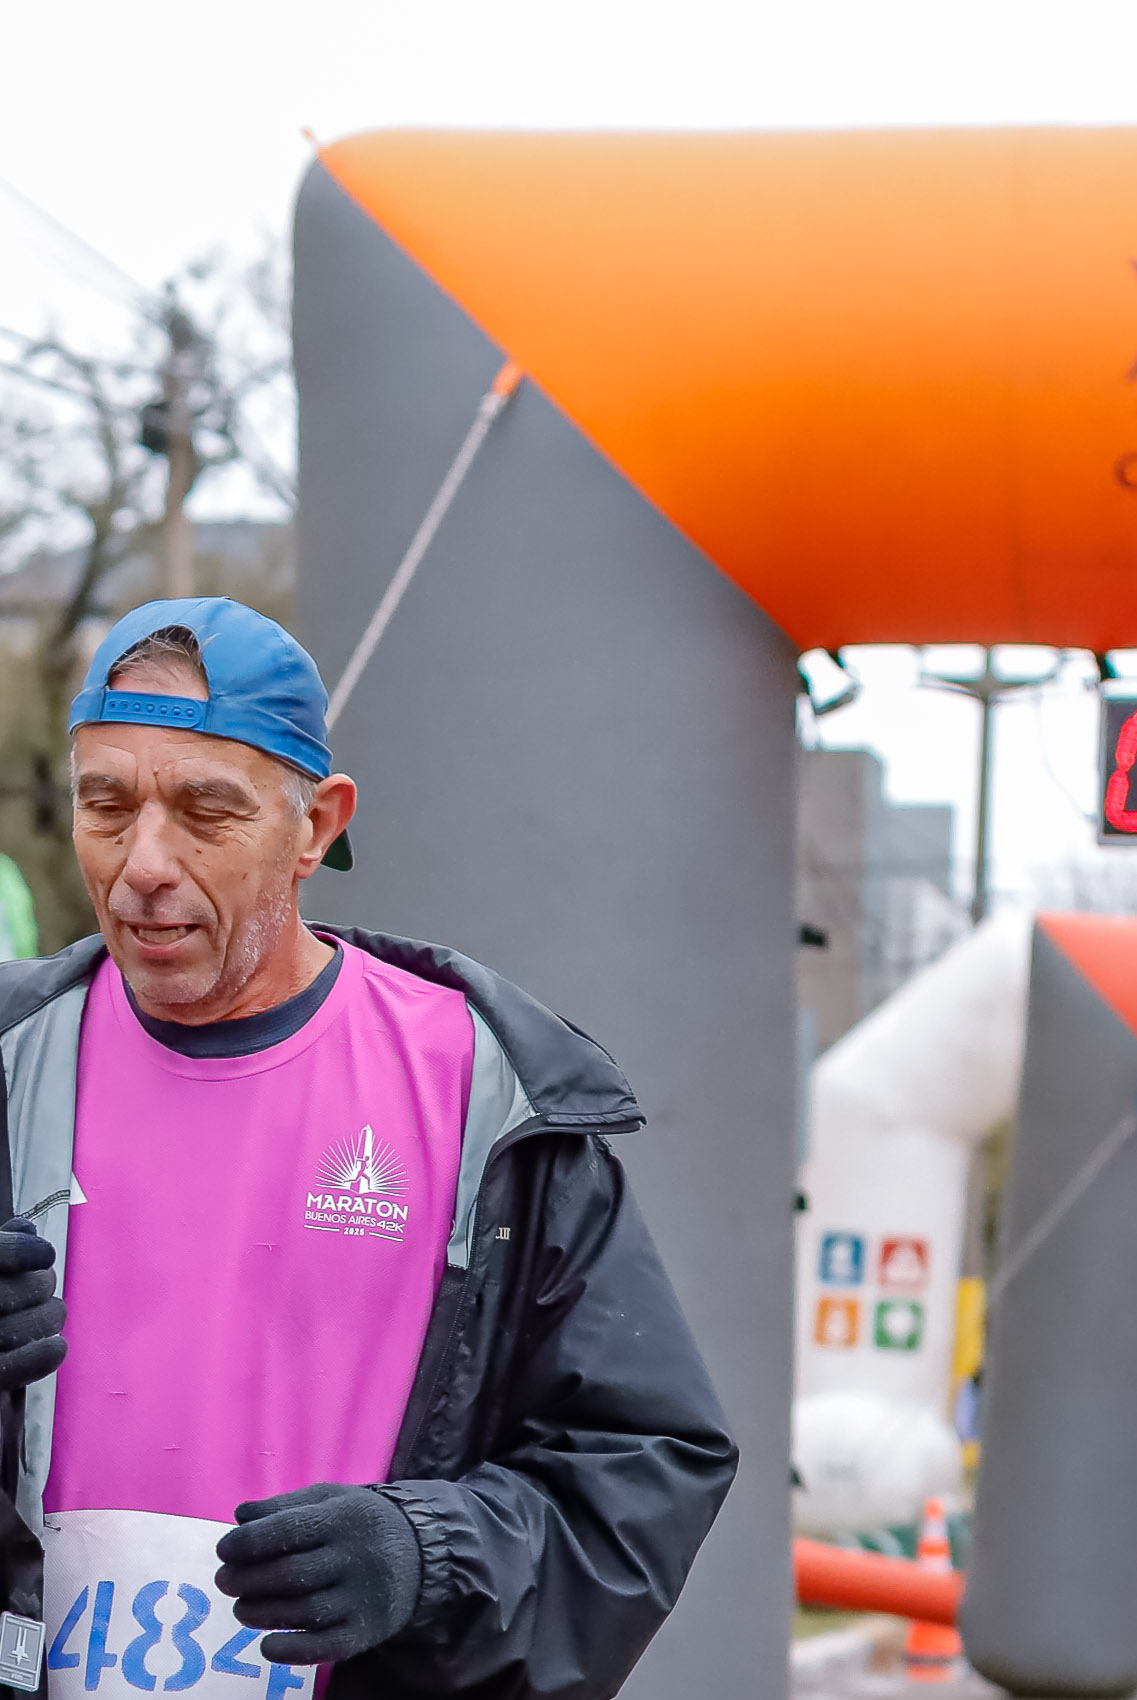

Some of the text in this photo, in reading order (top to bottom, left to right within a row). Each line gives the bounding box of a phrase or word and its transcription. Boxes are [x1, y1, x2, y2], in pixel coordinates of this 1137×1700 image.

[306, 1191, 409, 1221] MARATON
[304, 1210, 405, 1234] BUENOS AIRES 42K
